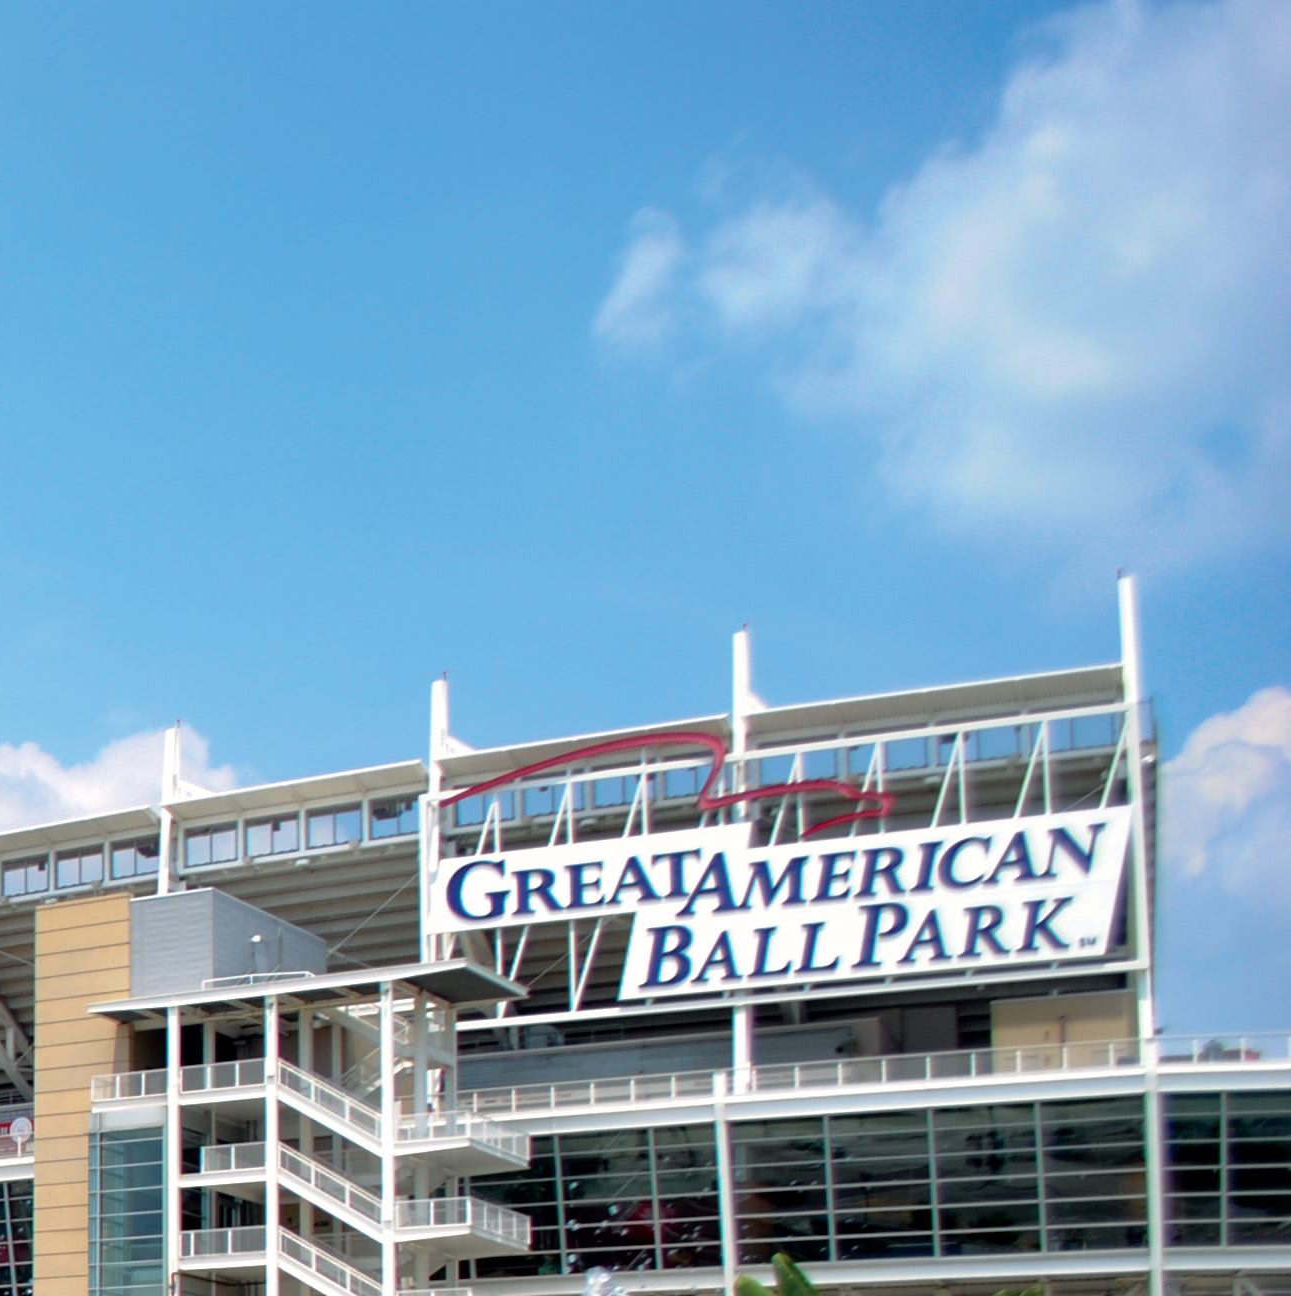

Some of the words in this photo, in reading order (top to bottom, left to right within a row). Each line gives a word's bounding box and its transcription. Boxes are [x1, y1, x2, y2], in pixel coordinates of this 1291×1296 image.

[446, 848, 702, 921] GREAT
[675, 822, 1106, 918] AMERICAN
[638, 922, 841, 990] BALL
[851, 896, 1075, 968] PARK
